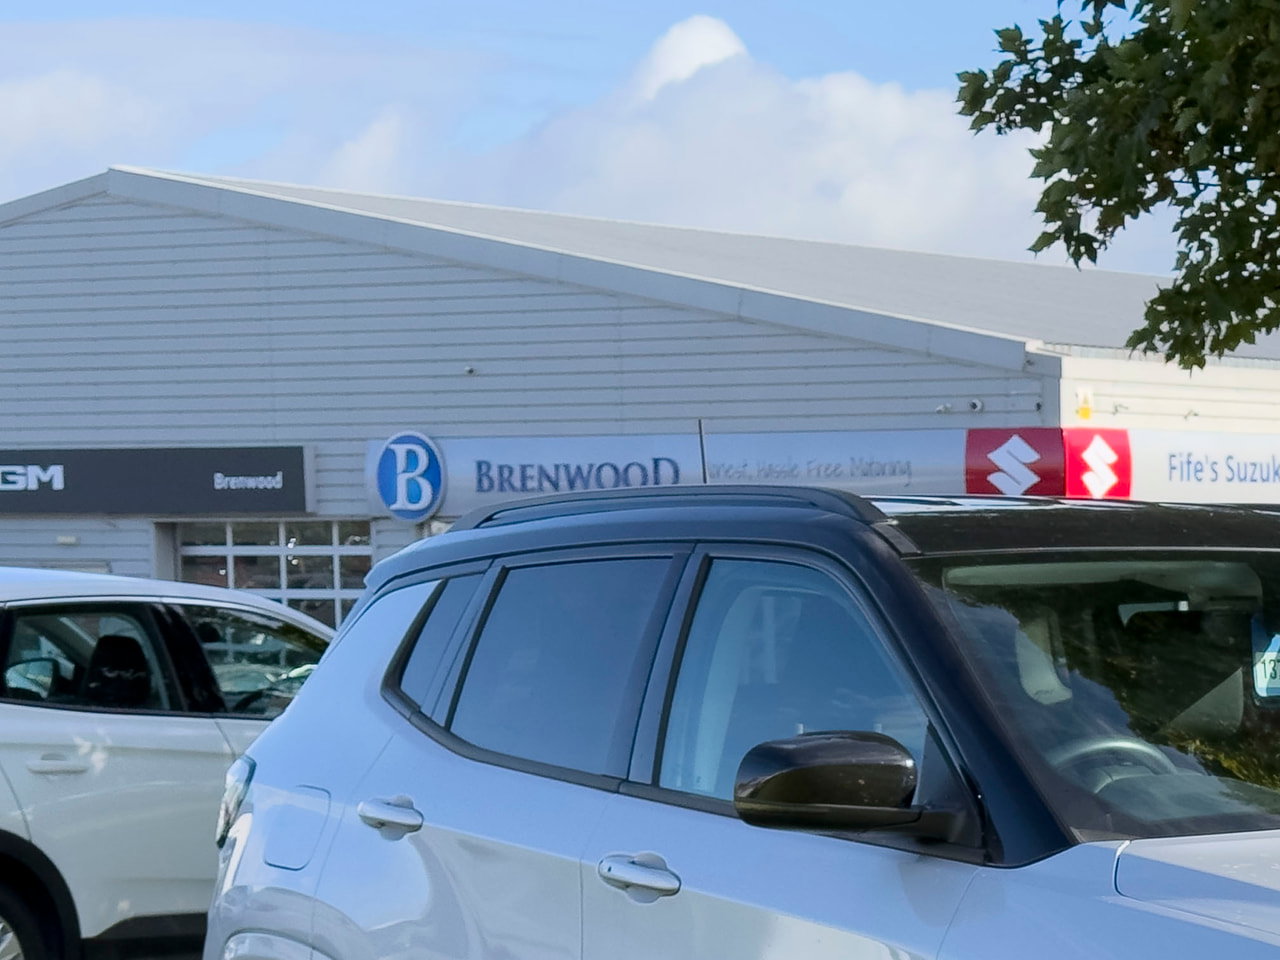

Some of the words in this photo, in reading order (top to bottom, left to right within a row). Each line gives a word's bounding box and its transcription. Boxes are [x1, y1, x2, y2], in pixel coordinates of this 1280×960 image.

[388, 443, 433, 510] B
[475, 457, 680, 492] BRENWOOD
[806, 459, 843, 478] Free
[1168, 453, 1218, 482] Fife's
